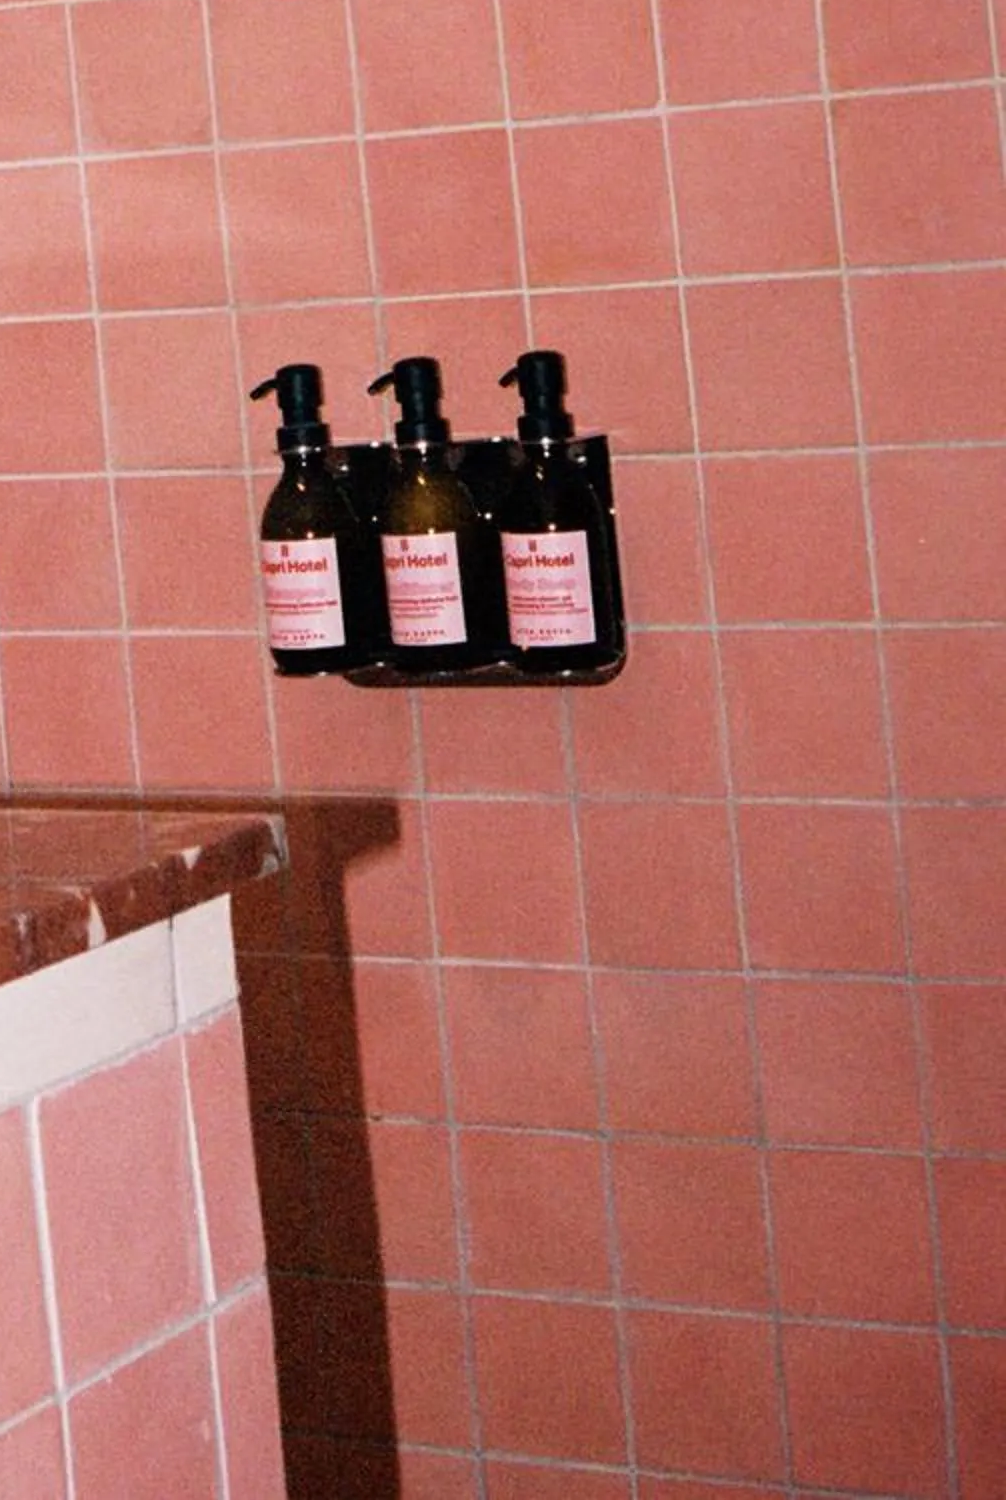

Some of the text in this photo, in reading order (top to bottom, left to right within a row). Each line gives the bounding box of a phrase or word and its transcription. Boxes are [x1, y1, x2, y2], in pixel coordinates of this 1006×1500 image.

[287, 557, 328, 573] Hotel
[385, 553, 448, 571] apri Hotel
[535, 552, 574, 567] Hotel
